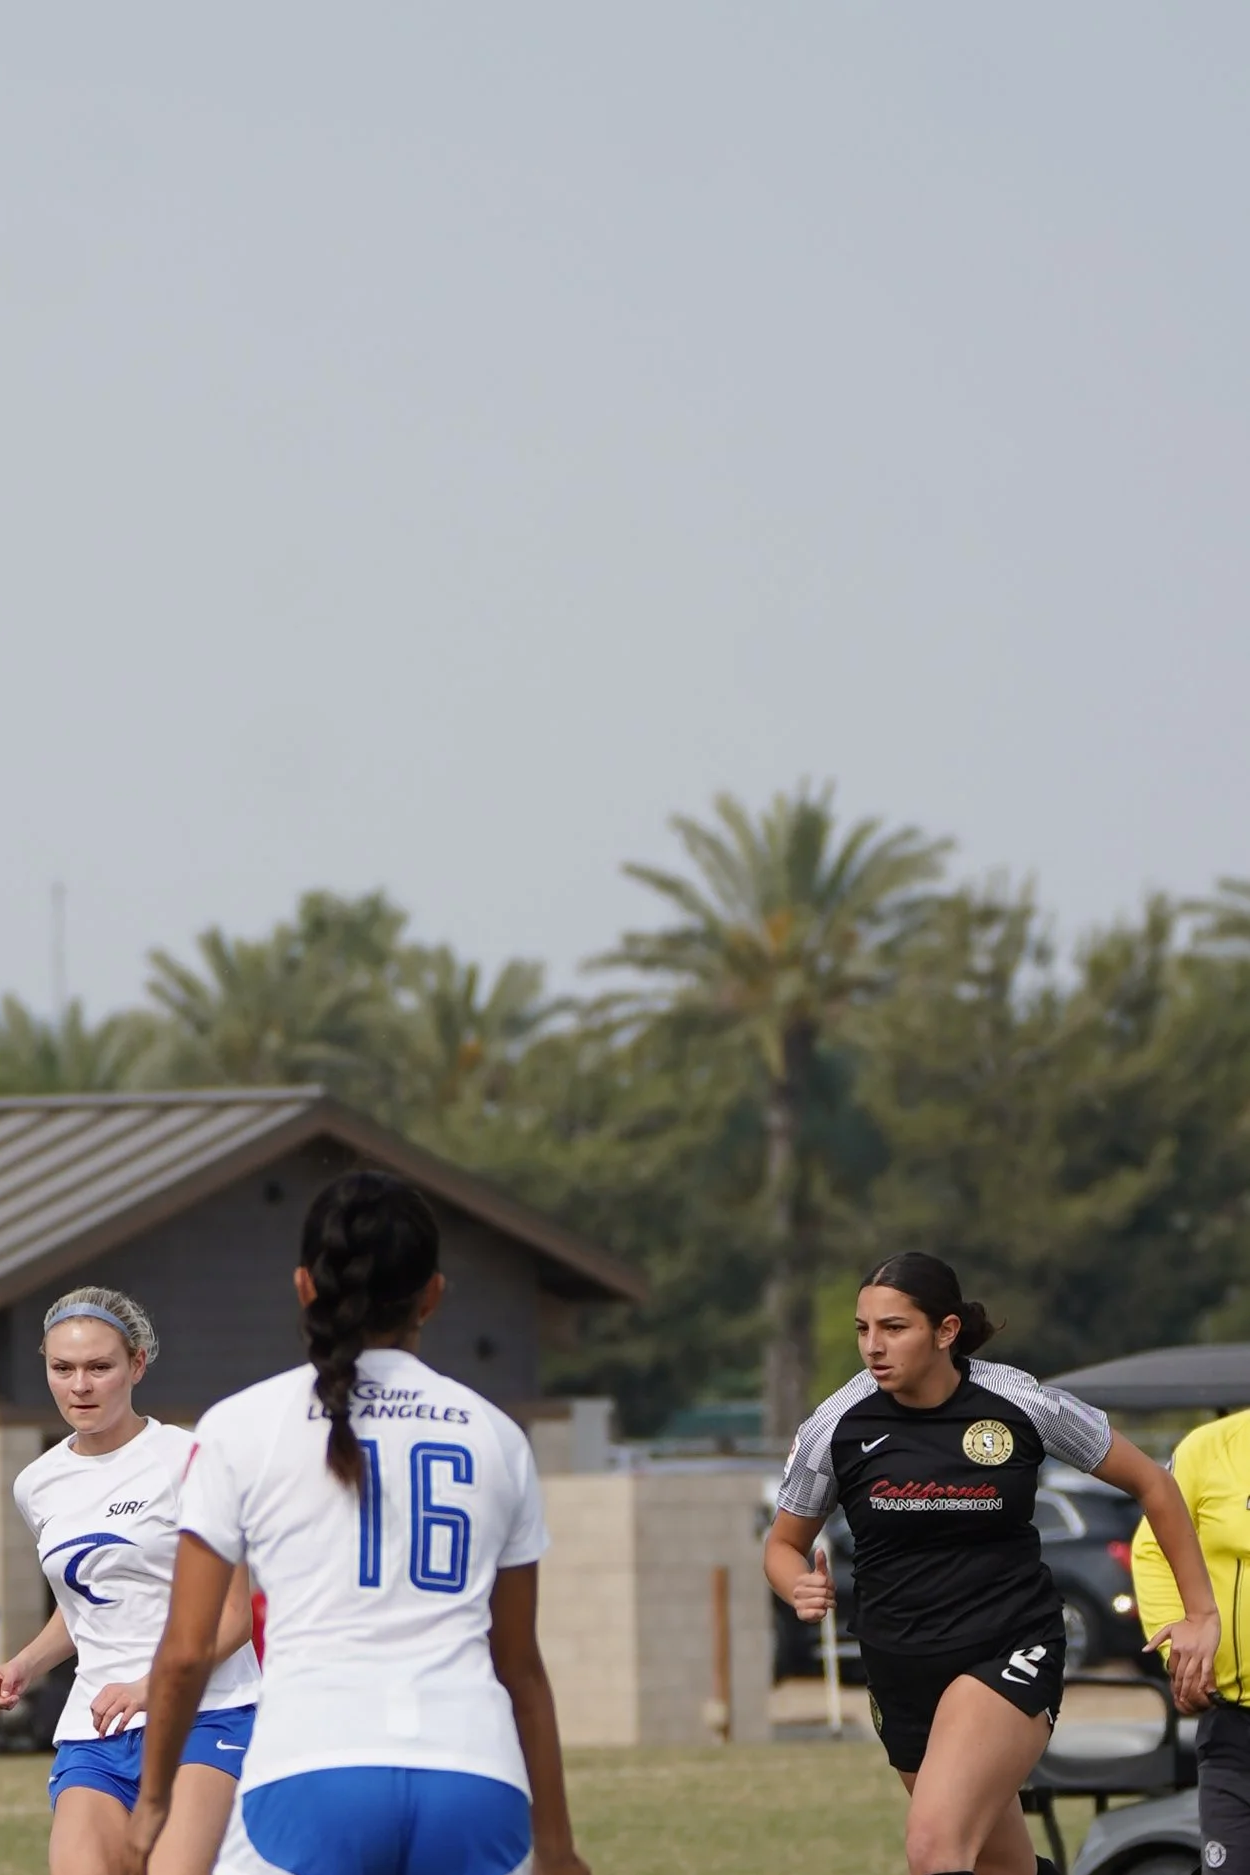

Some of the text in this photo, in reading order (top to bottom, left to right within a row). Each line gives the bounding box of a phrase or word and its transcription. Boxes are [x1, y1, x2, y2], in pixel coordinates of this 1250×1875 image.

[358, 1403, 472, 1425] ANGELES
[870, 1480, 999, 1498] California
[105, 1499, 148, 1518] SURF
[869, 1497, 1003, 1511] TRANSMISSION
[357, 1439, 474, 1594] 16
